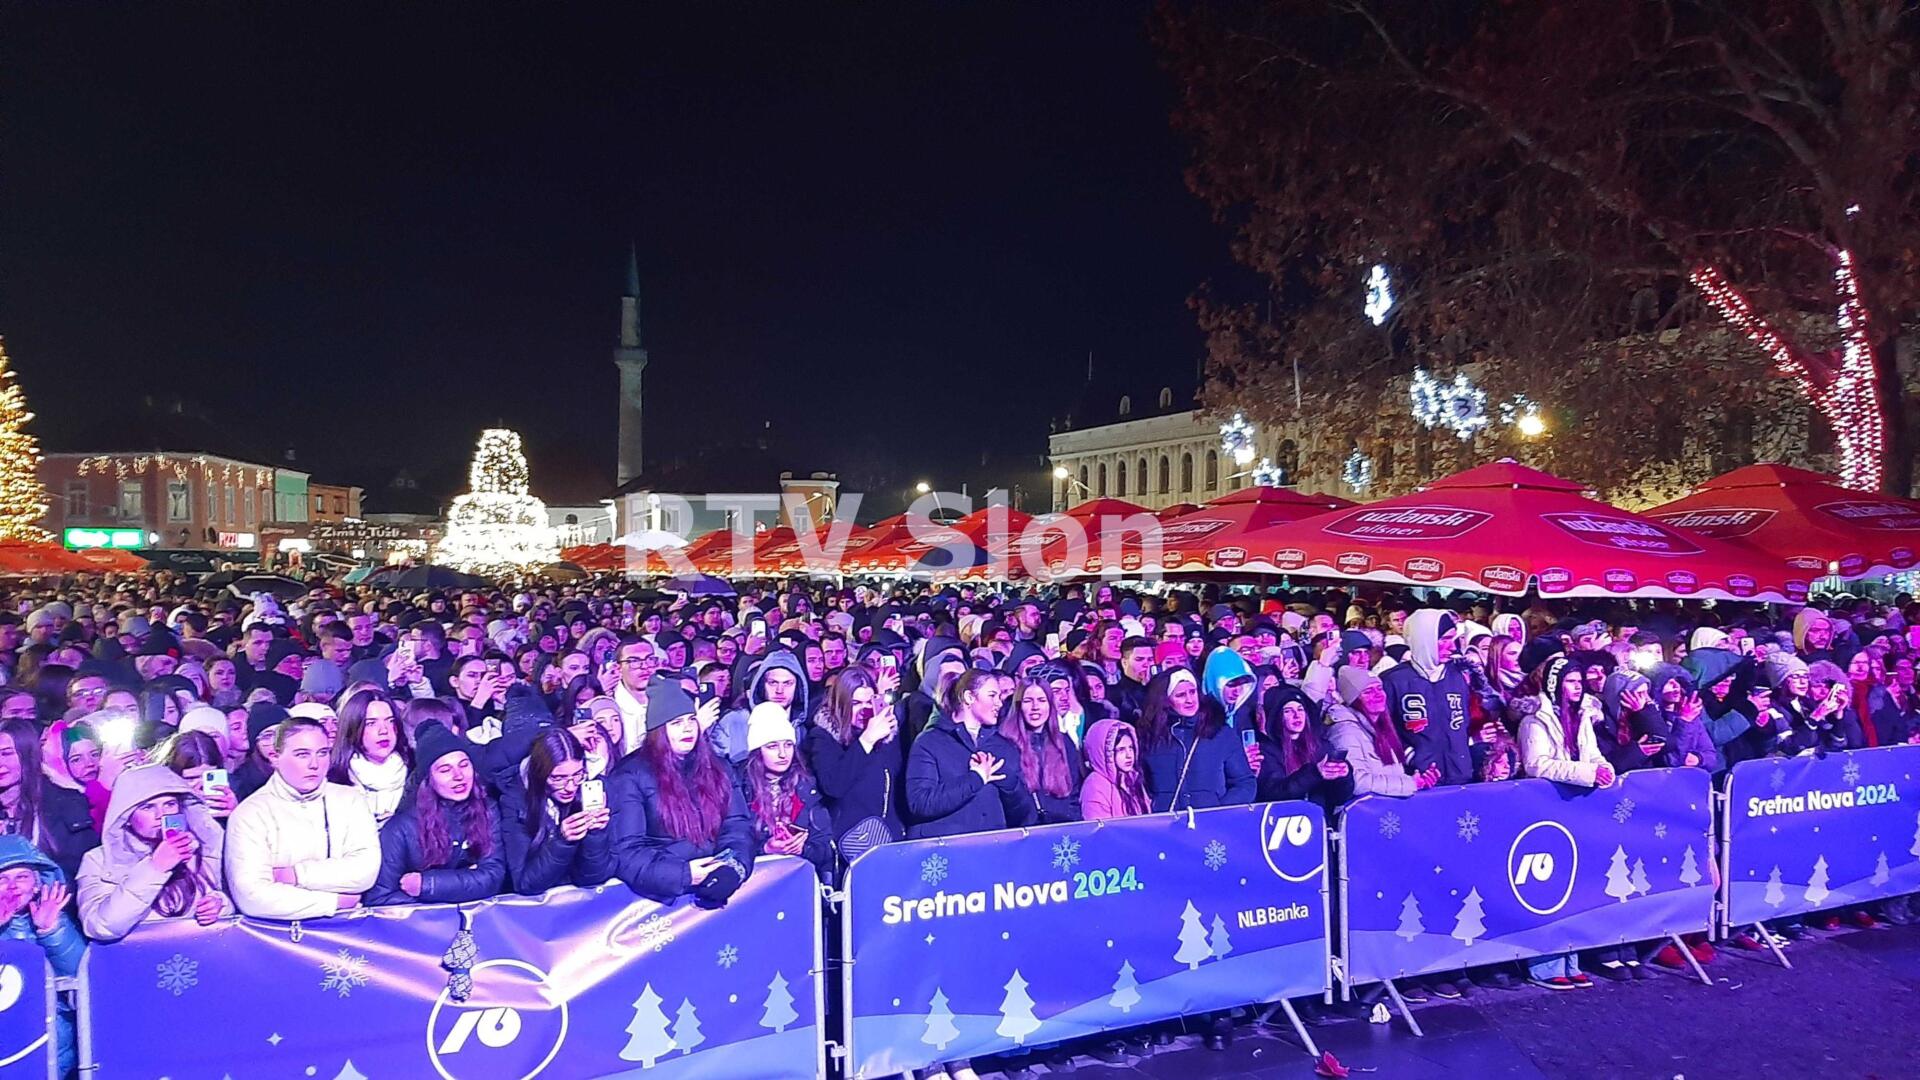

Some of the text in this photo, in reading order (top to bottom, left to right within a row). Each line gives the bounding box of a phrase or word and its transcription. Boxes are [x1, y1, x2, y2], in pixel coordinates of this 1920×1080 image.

[1349, 523, 1425, 536] pilsner
[1355, 508, 1475, 527] tuzlanski
[1747, 783, 1900, 818] Sretna Nova 2024.
[881, 865, 1145, 925] Sretna Nova 2024.
[1237, 902, 1309, 929] NLB Banka
